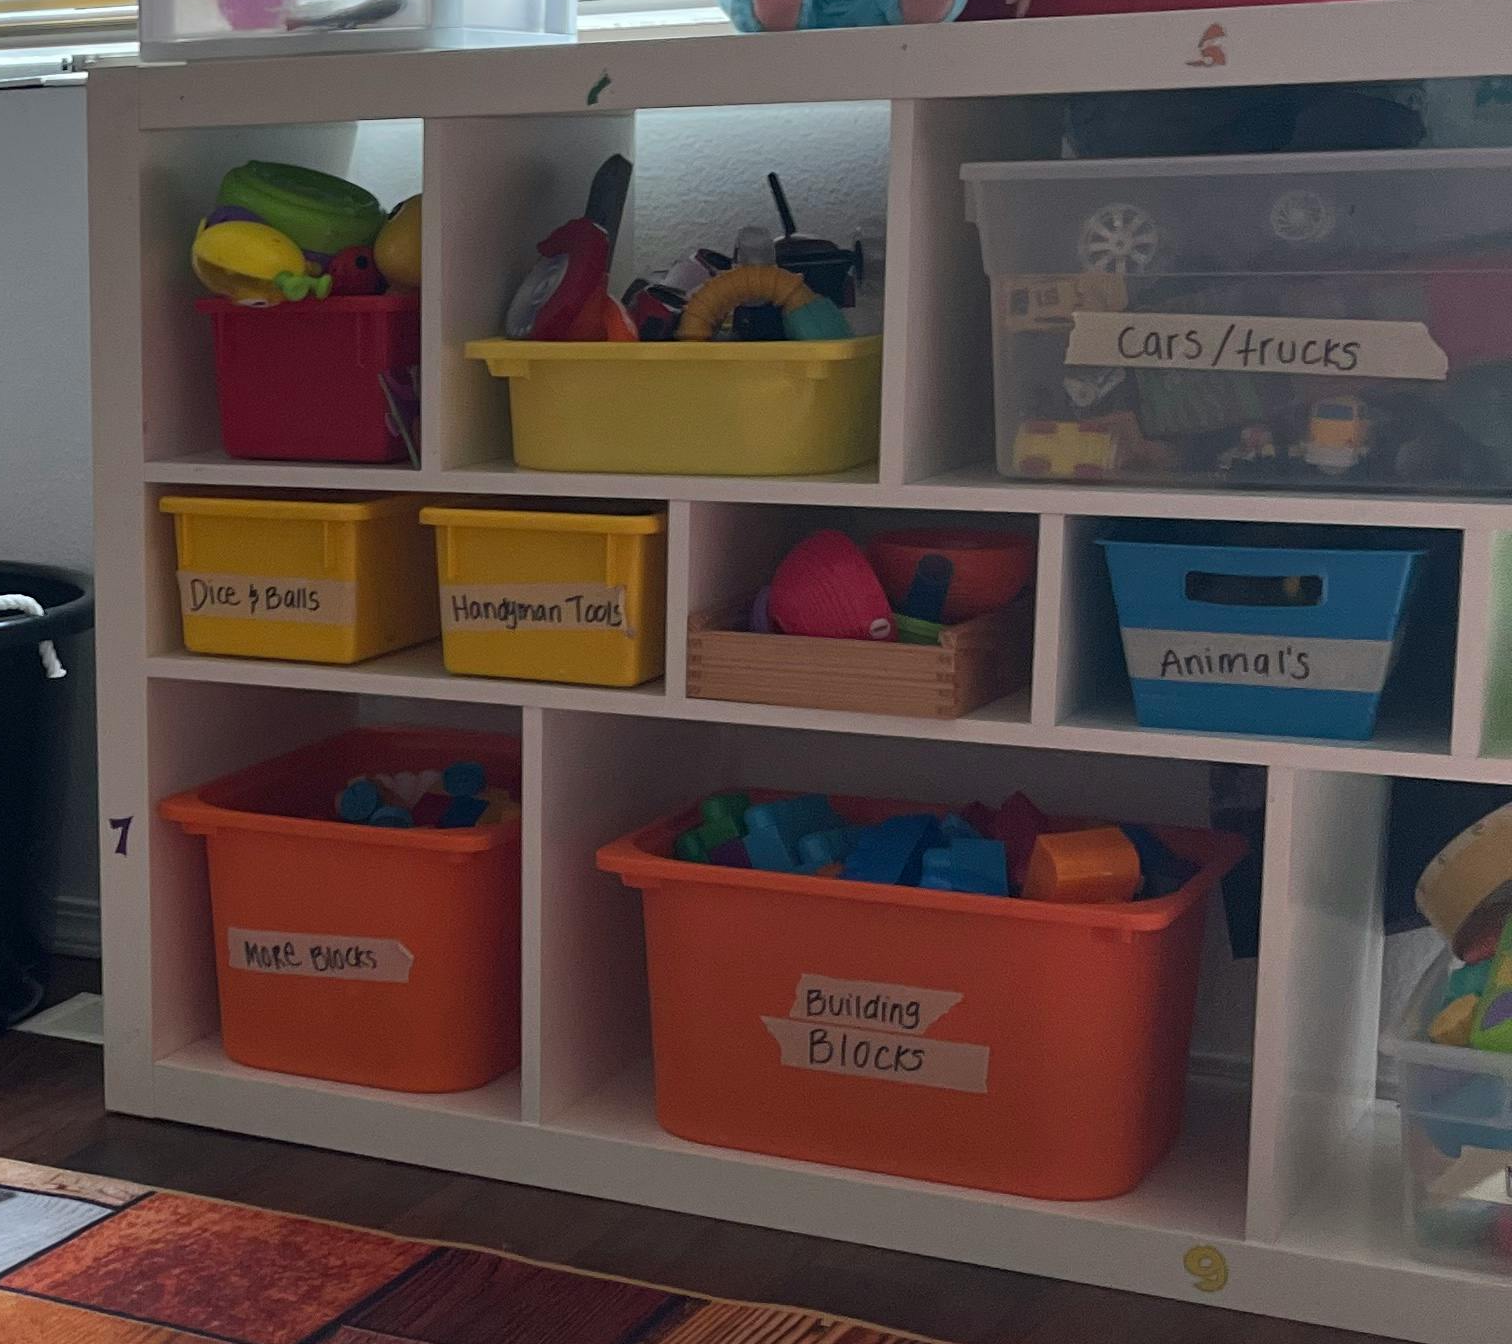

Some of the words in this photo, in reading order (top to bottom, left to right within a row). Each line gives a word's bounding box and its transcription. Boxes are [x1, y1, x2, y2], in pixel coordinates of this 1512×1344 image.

[190, 578, 241, 612] Dice
[265, 586, 320, 611] Balls
[451, 594, 562, 630] Handyman
[565, 595, 623, 627] Tools
[1160, 646, 1311, 680] Animal's
[109, 816, 134, 856] 7
[807, 989, 921, 1029] Building
[809, 1028, 926, 1072] Blocks
[1183, 1245, 1229, 1293] 9
